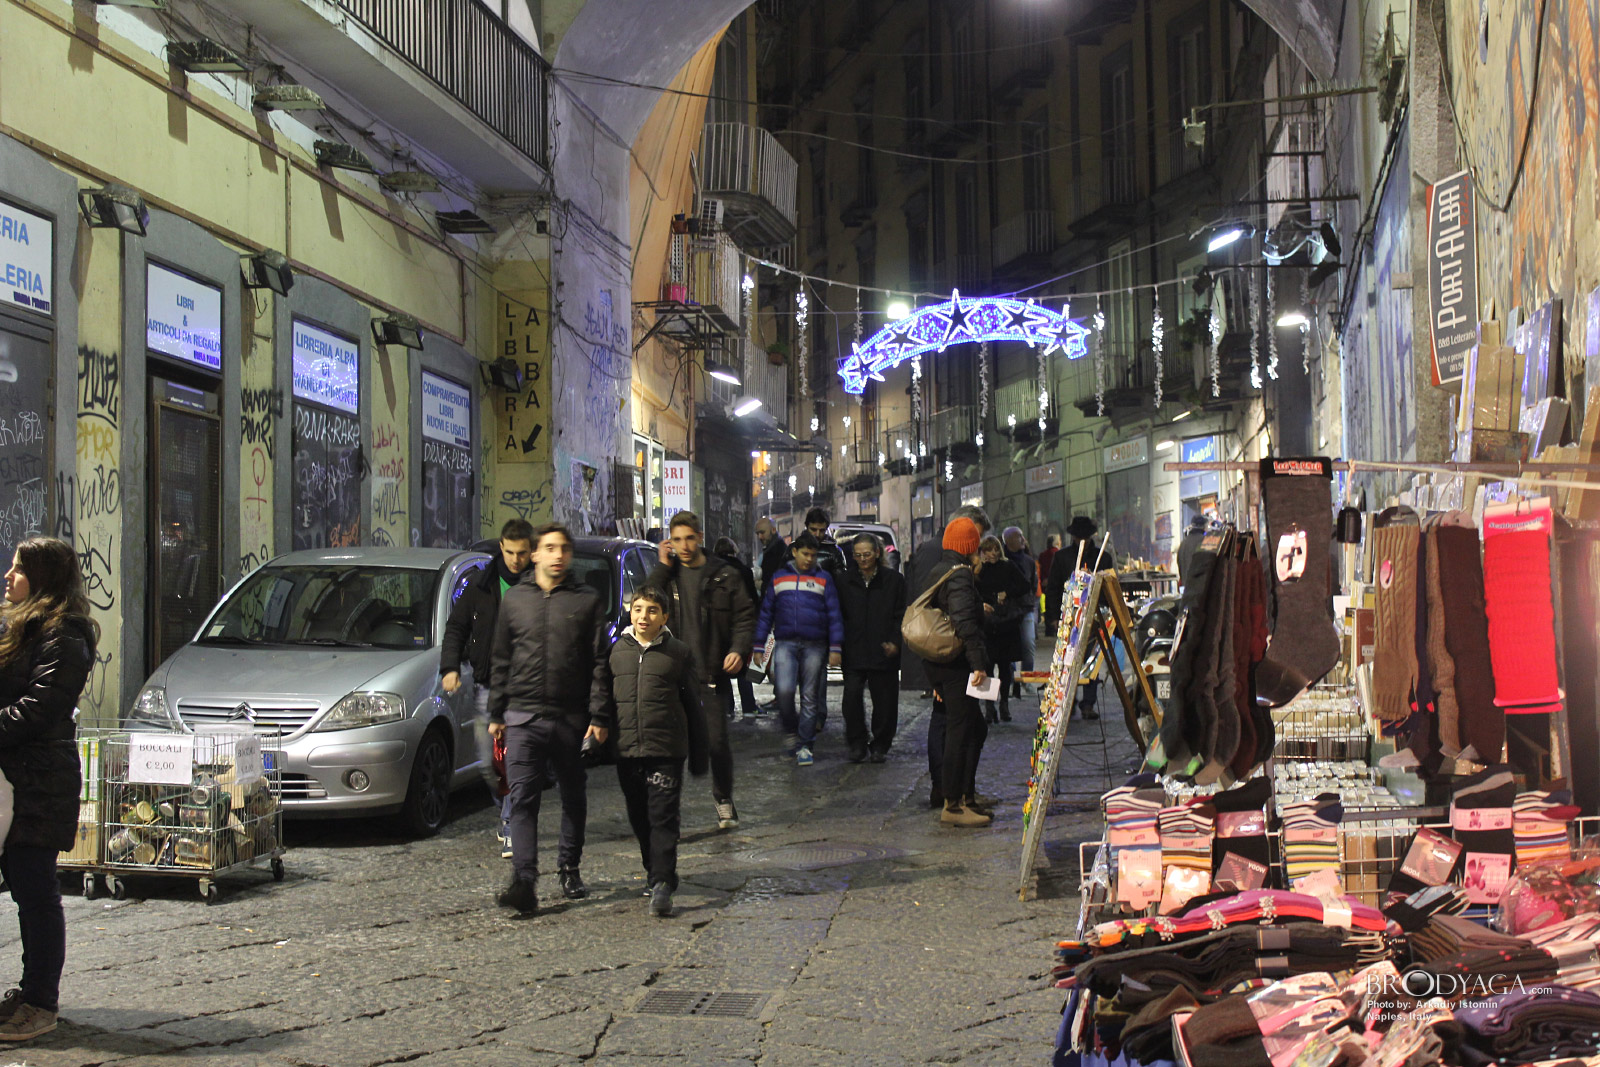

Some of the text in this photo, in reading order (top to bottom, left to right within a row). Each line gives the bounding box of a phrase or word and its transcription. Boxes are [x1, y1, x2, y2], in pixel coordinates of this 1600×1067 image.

[177, 294, 194, 311] LIBRI
[183, 315, 188, 327] &
[148, 319, 181, 340] ARTICOLI
[1450, 330, 1476, 345] Letterario
[296, 332, 356, 368] LIBRERIA ALBA
[423, 382, 470, 408] COMPRAVENDITA
[439, 403, 454, 419] LIBRI
[427, 415, 467, 439] NUOVI E USATI
[139, 743, 183, 754] BOCCALI
[154, 761, 175, 771] 2,00
[1402, 866, 1420, 878] MODA
